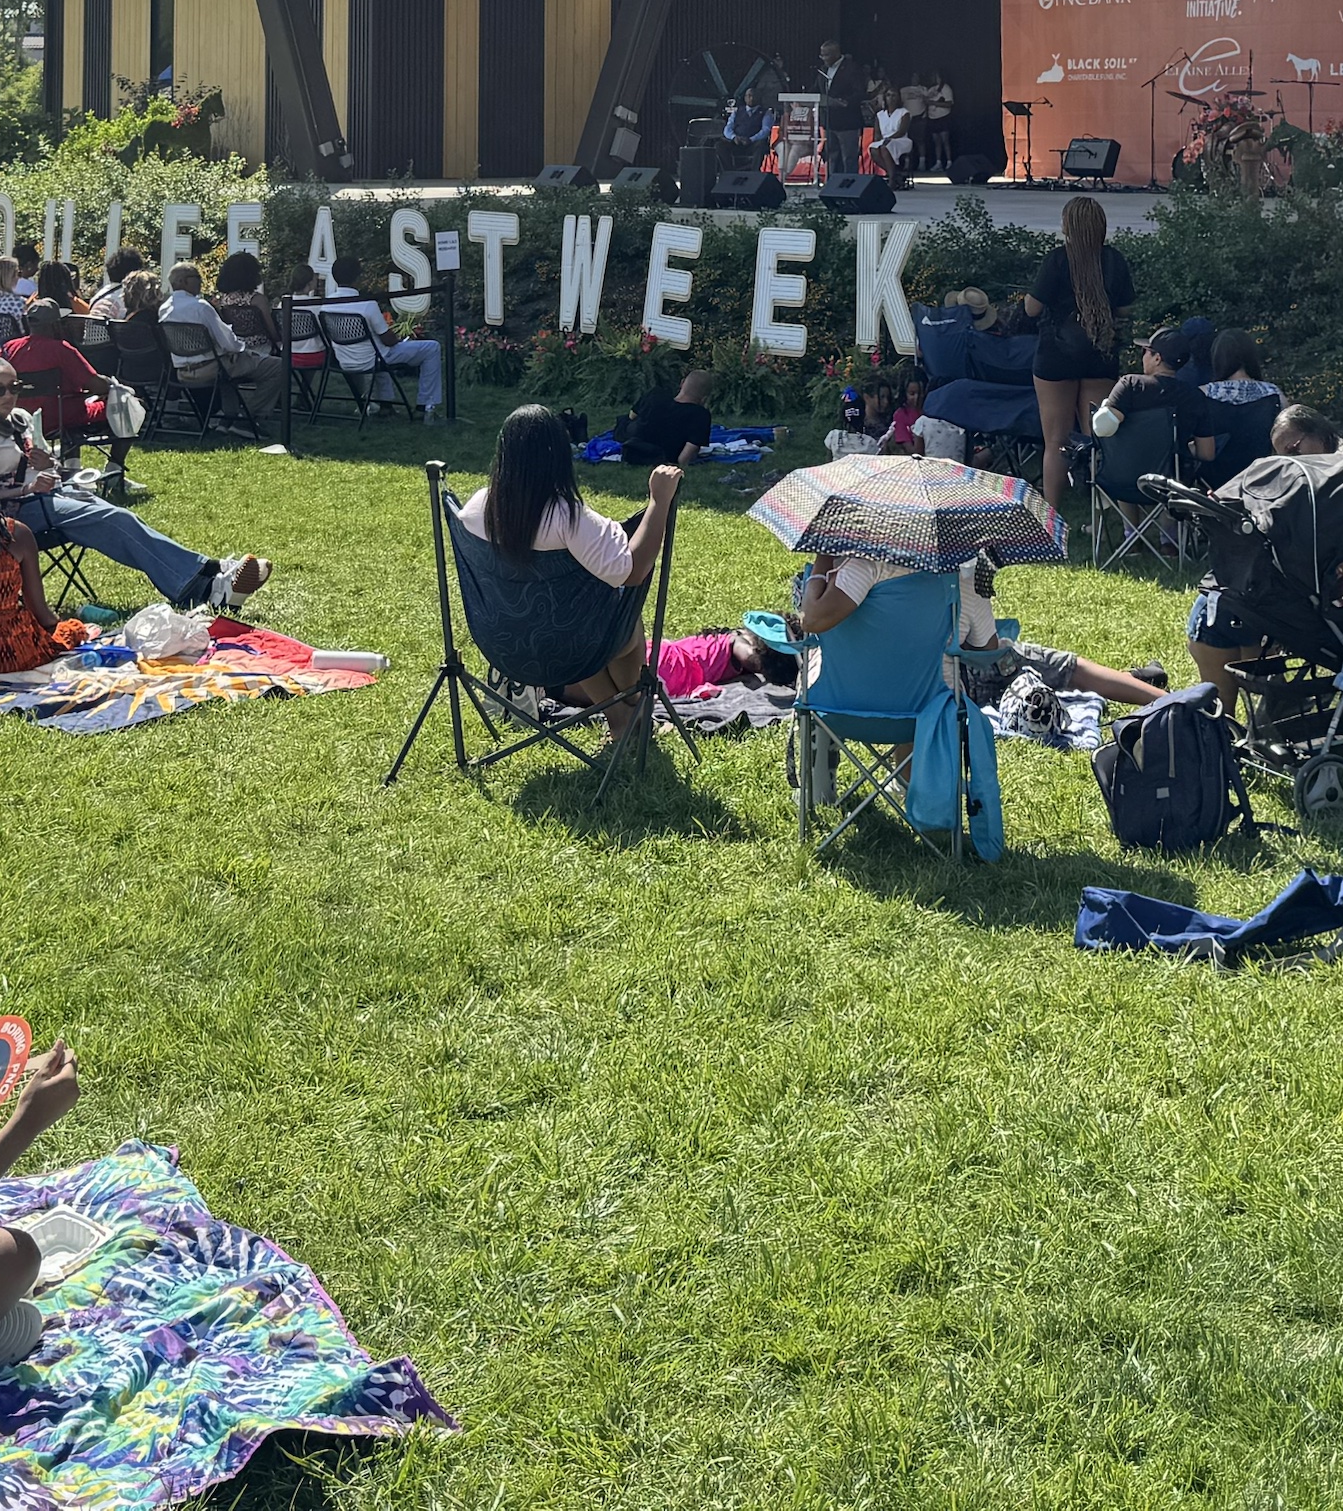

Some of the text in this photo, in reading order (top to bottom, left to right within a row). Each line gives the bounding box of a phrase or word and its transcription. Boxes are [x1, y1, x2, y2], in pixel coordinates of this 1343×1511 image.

[1067, 58, 1101, 70] BLACK
[1104, 57, 1127, 69] SOIL
[559, 213, 919, 358] WEEK
